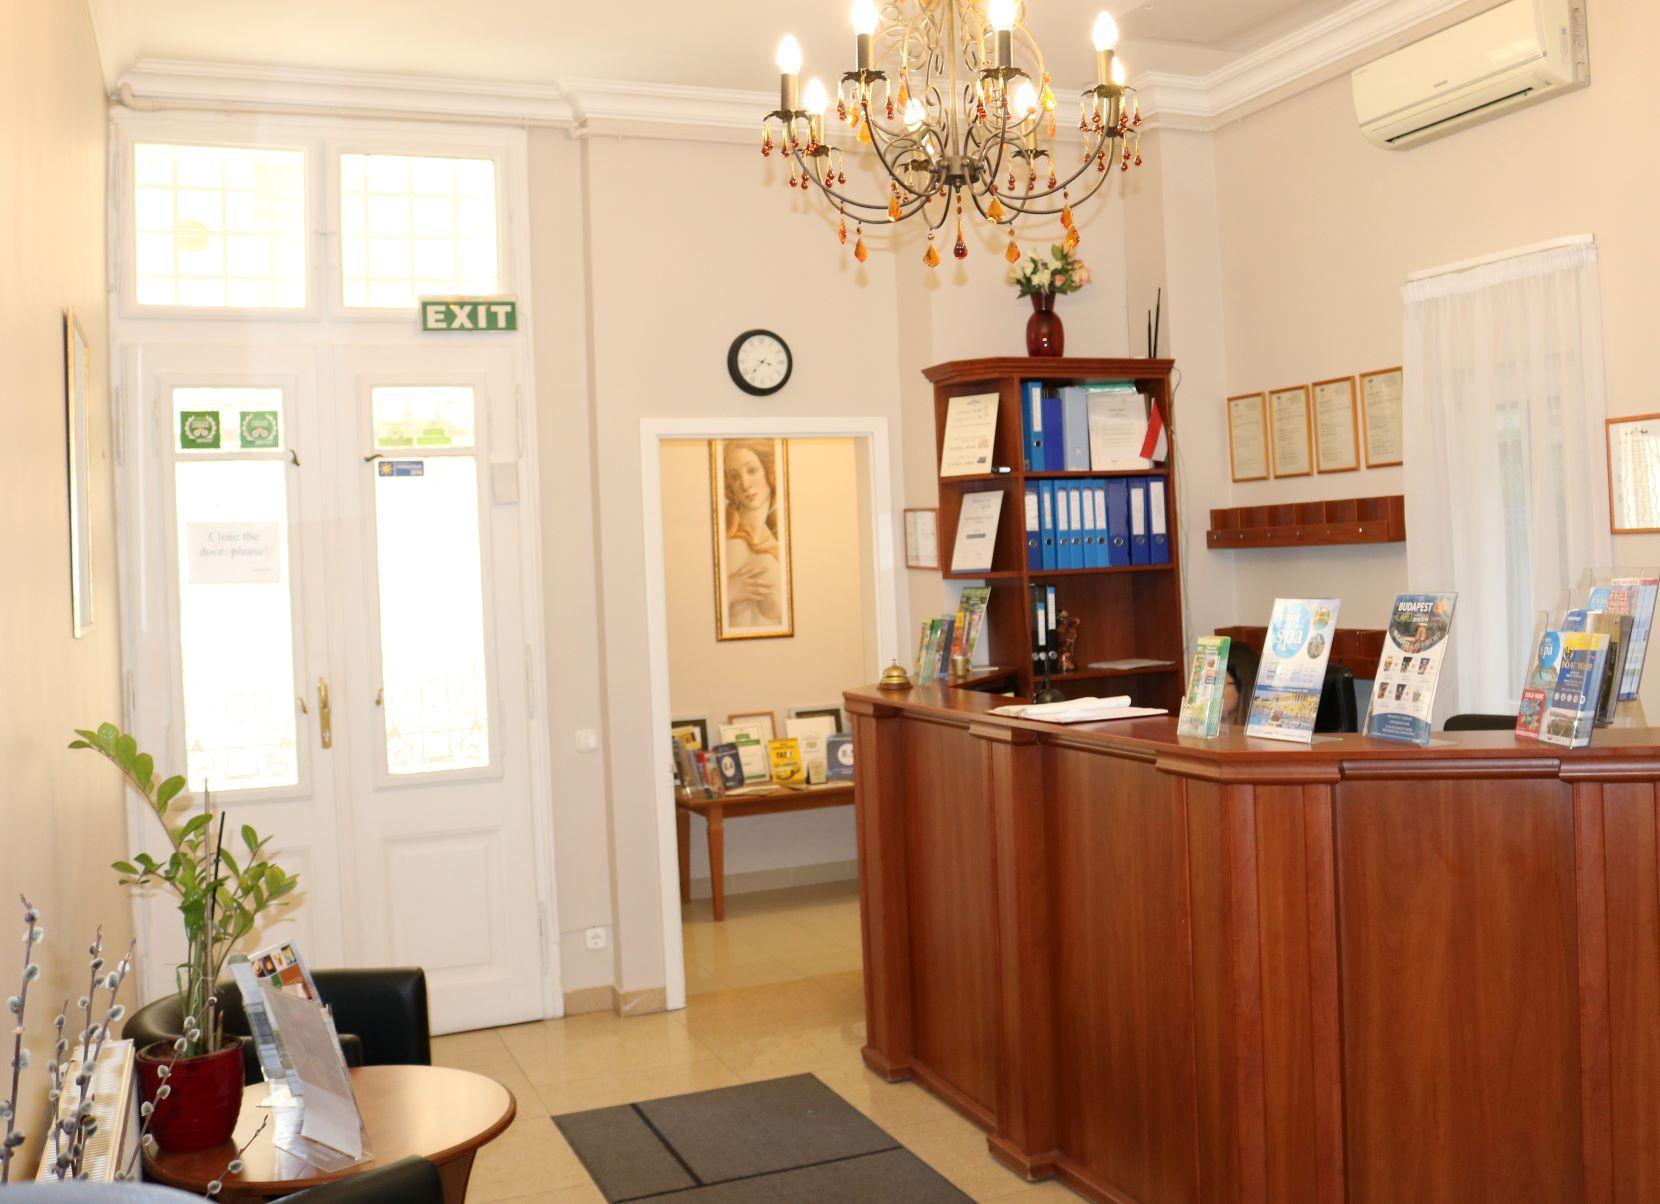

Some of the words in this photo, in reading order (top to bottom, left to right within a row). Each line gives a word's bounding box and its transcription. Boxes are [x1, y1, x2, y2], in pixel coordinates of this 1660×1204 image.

[425, 304, 512, 329] EXIT
[208, 531, 240, 542] Close
[242, 531, 261, 542] the
[199, 546, 228, 558] door,
[1398, 601, 1433, 612] BUDAPEST
[1277, 629, 1303, 652] spa
